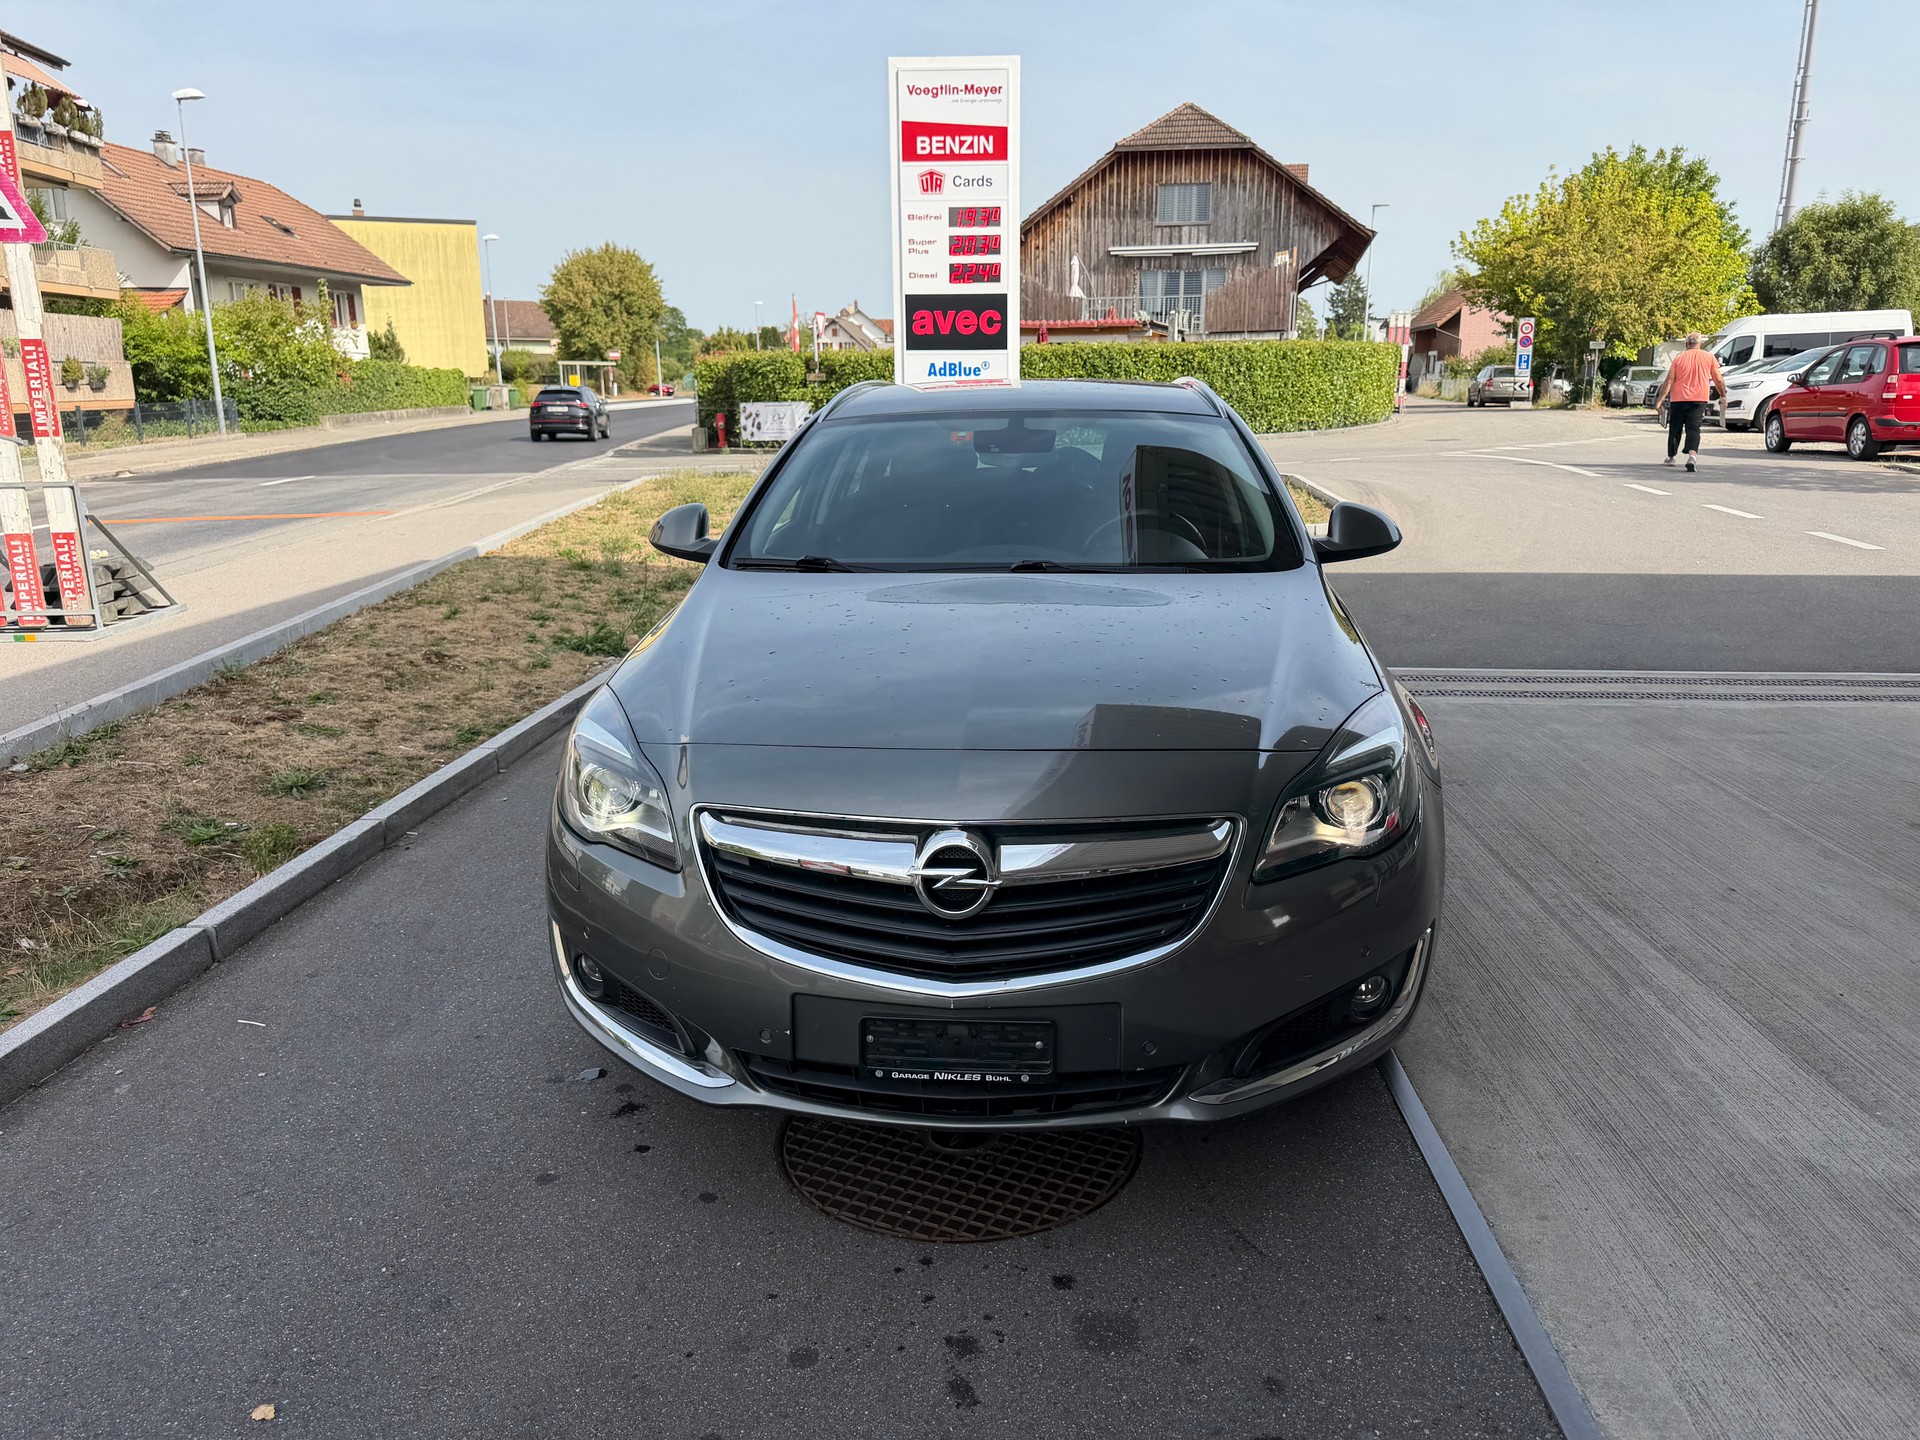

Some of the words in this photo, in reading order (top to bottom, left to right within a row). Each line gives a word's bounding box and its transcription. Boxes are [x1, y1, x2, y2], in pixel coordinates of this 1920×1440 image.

[906, 84, 1003, 98] Voegtlin-Meyer
[916, 135, 994, 155] BENZIN
[952, 174, 993, 188] Cards
[907, 213, 942, 221] Bleifrei
[908, 238, 938, 247] Super
[908, 247, 929, 255] Plus
[908, 271, 938, 279] Diesel
[912, 309, 1002, 335] avec
[24, 345, 48, 431] IMPERIALI
[10, 541, 33, 621] IMPERIALI
[891, 1071, 930, 1080] GARAGE
[933, 1071, 981, 1081] NIKLES
